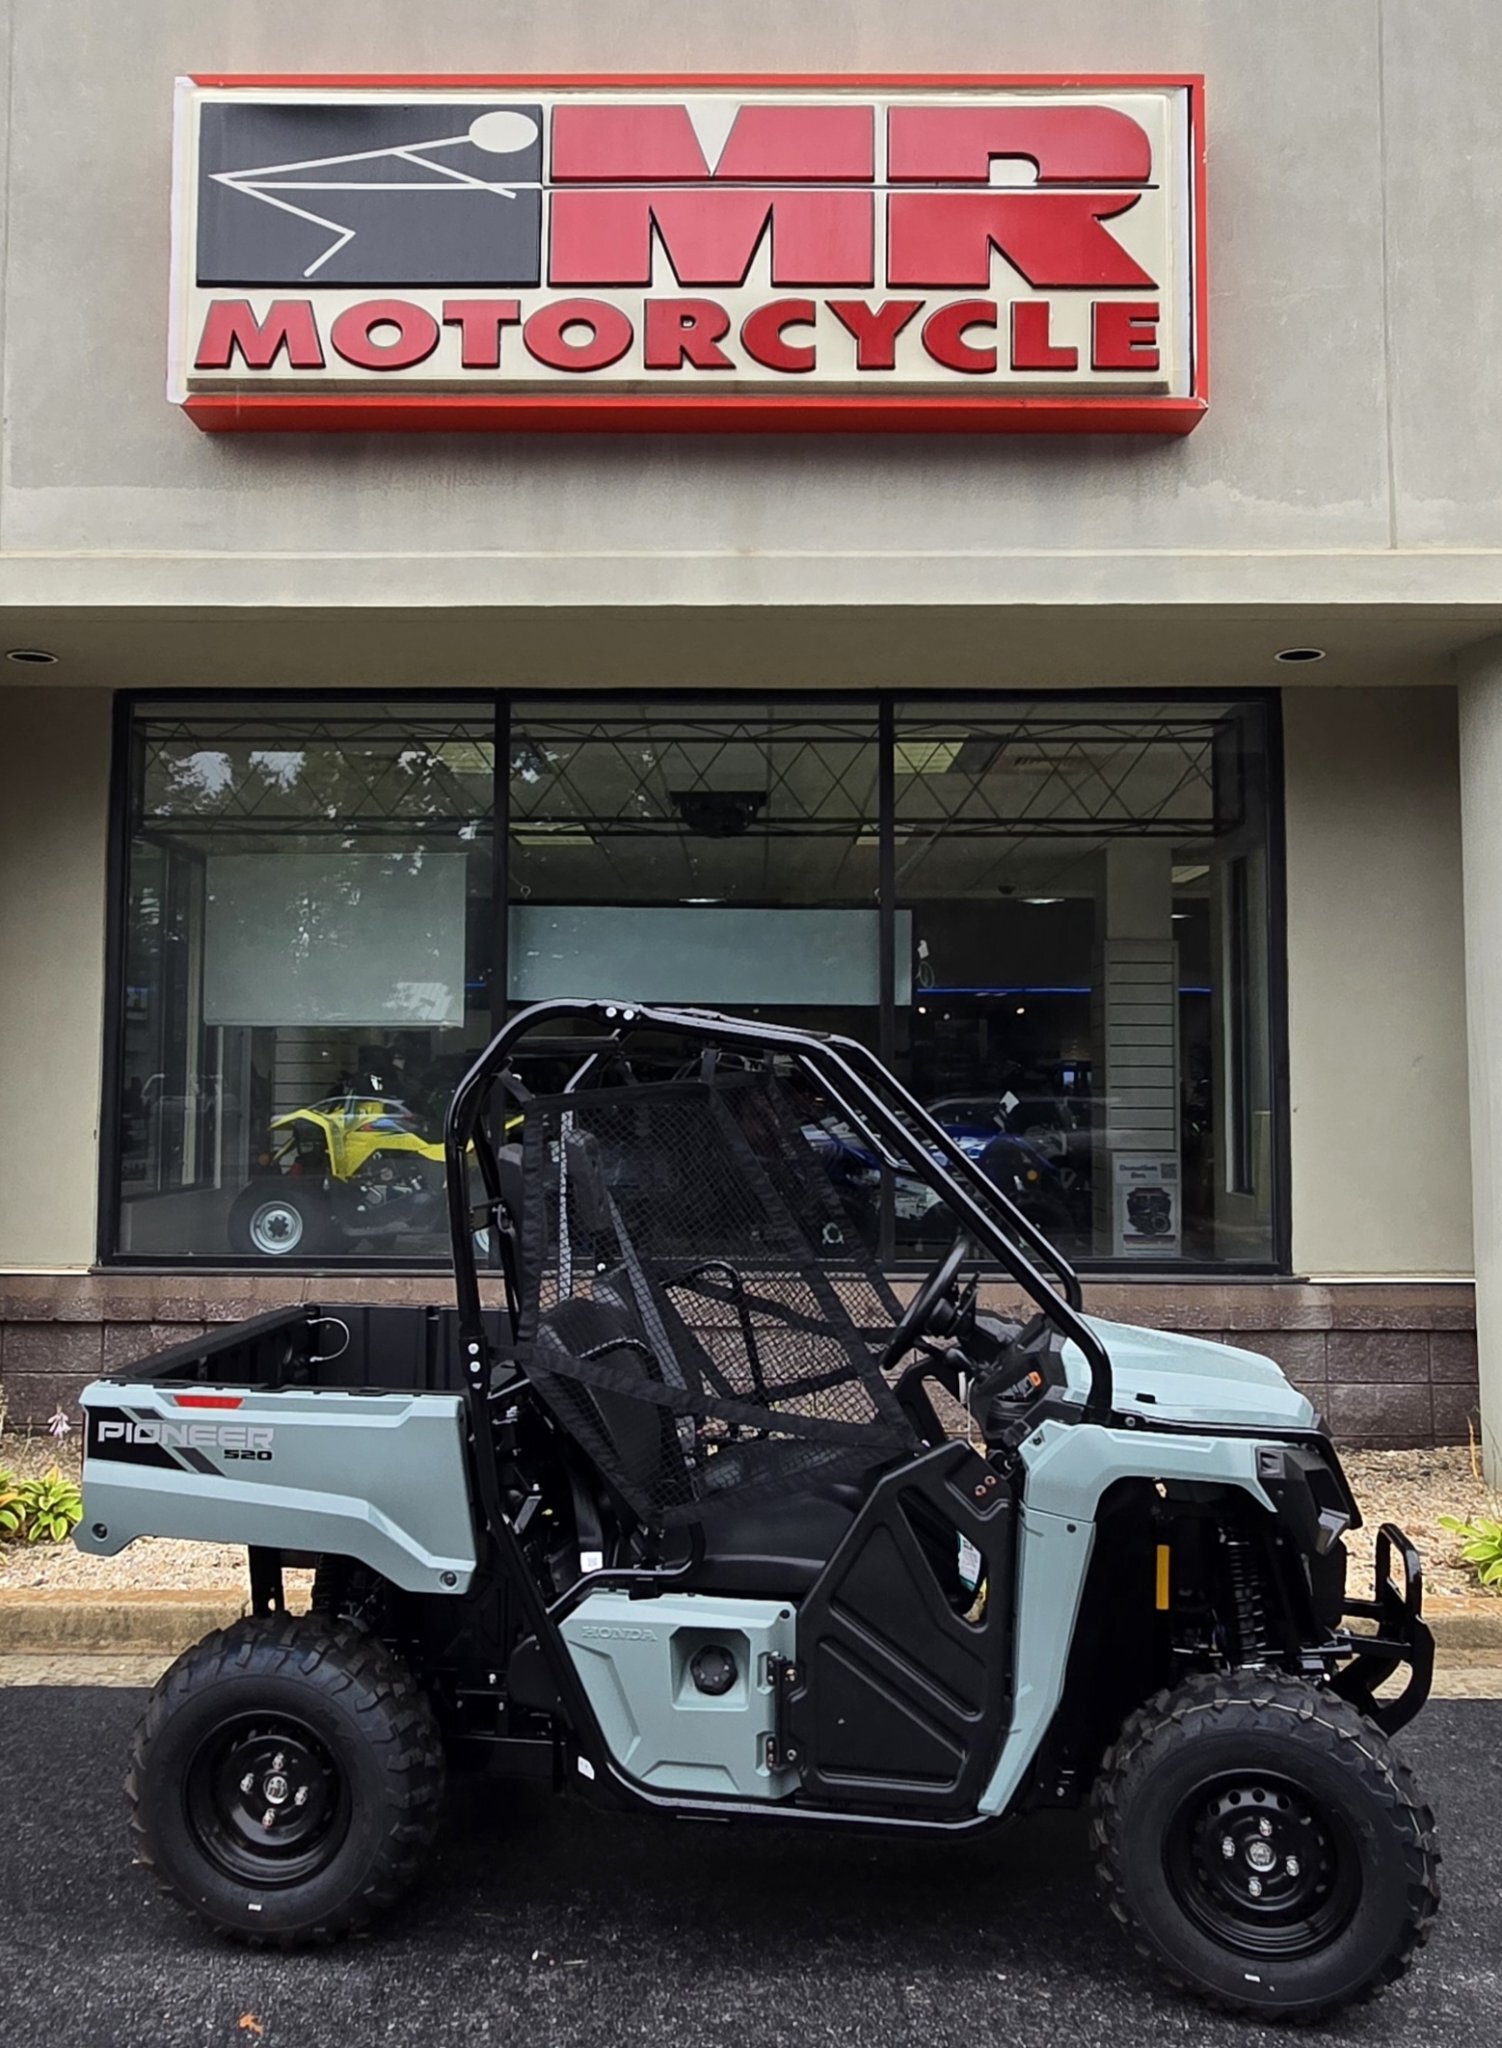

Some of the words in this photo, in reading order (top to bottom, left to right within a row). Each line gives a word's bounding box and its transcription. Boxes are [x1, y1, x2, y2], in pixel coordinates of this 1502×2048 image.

[546, 103, 1160, 290] MR
[194, 298, 1160, 372] MOTORCYCLE
[97, 1421, 274, 1449] PIONEER
[223, 1449, 273, 1461] 520
[581, 1626, 657, 1642] HONDA
